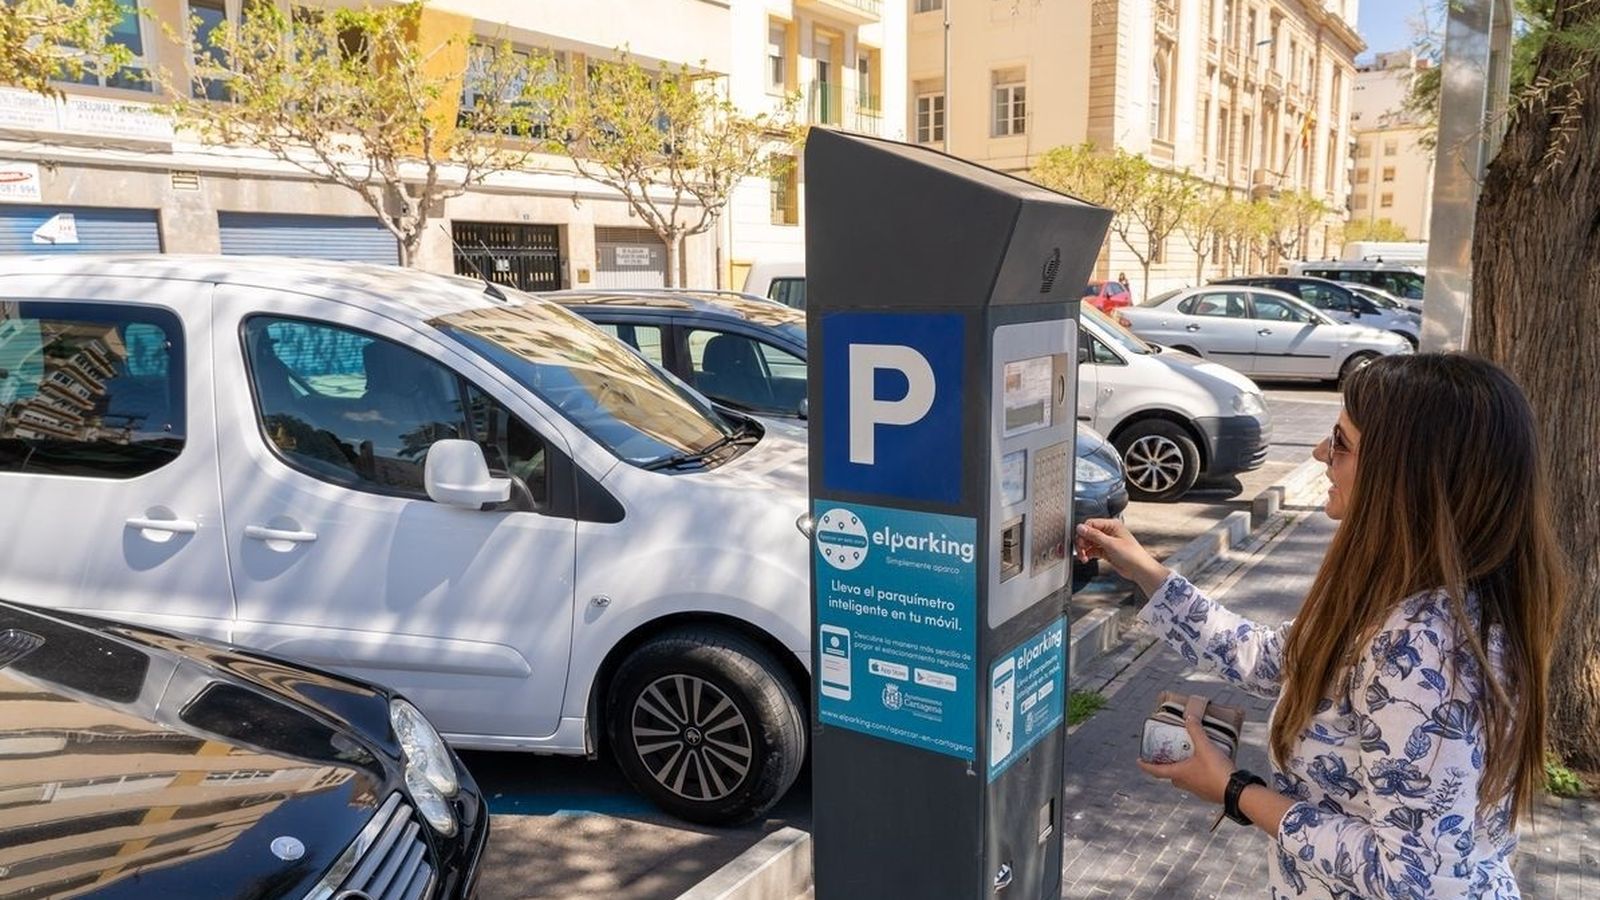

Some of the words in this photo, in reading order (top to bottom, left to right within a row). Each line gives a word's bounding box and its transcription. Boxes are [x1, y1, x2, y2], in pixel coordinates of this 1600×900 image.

[849, 343, 936, 465] P
[872, 526, 974, 563] elparking
[886, 556, 931, 571] Simplemente
[831, 579, 861, 595] Lleva
[864, 585, 874, 597] el
[877, 589, 955, 612] parquímetro
[828, 595, 888, 617] inteligente
[891, 609, 906, 621] en
[909, 611, 921, 624] tu
[925, 614, 963, 631] móvil.
[853, 631, 886, 643] Descubre
[892, 639, 918, 650] manera
[935, 646, 961, 659] sencilla
[962, 652, 971, 661] de
[853, 641, 874, 652] pagar
[875, 644, 881, 653] el
[882, 645, 935, 664] estacionamiento
[936, 657, 970, 671] regulado.
[1017, 628, 1062, 670] elparking
[904, 698, 943, 715] Cartagena
[821, 710, 973, 753] www.elparking.com/aparcar-en-cartagena
